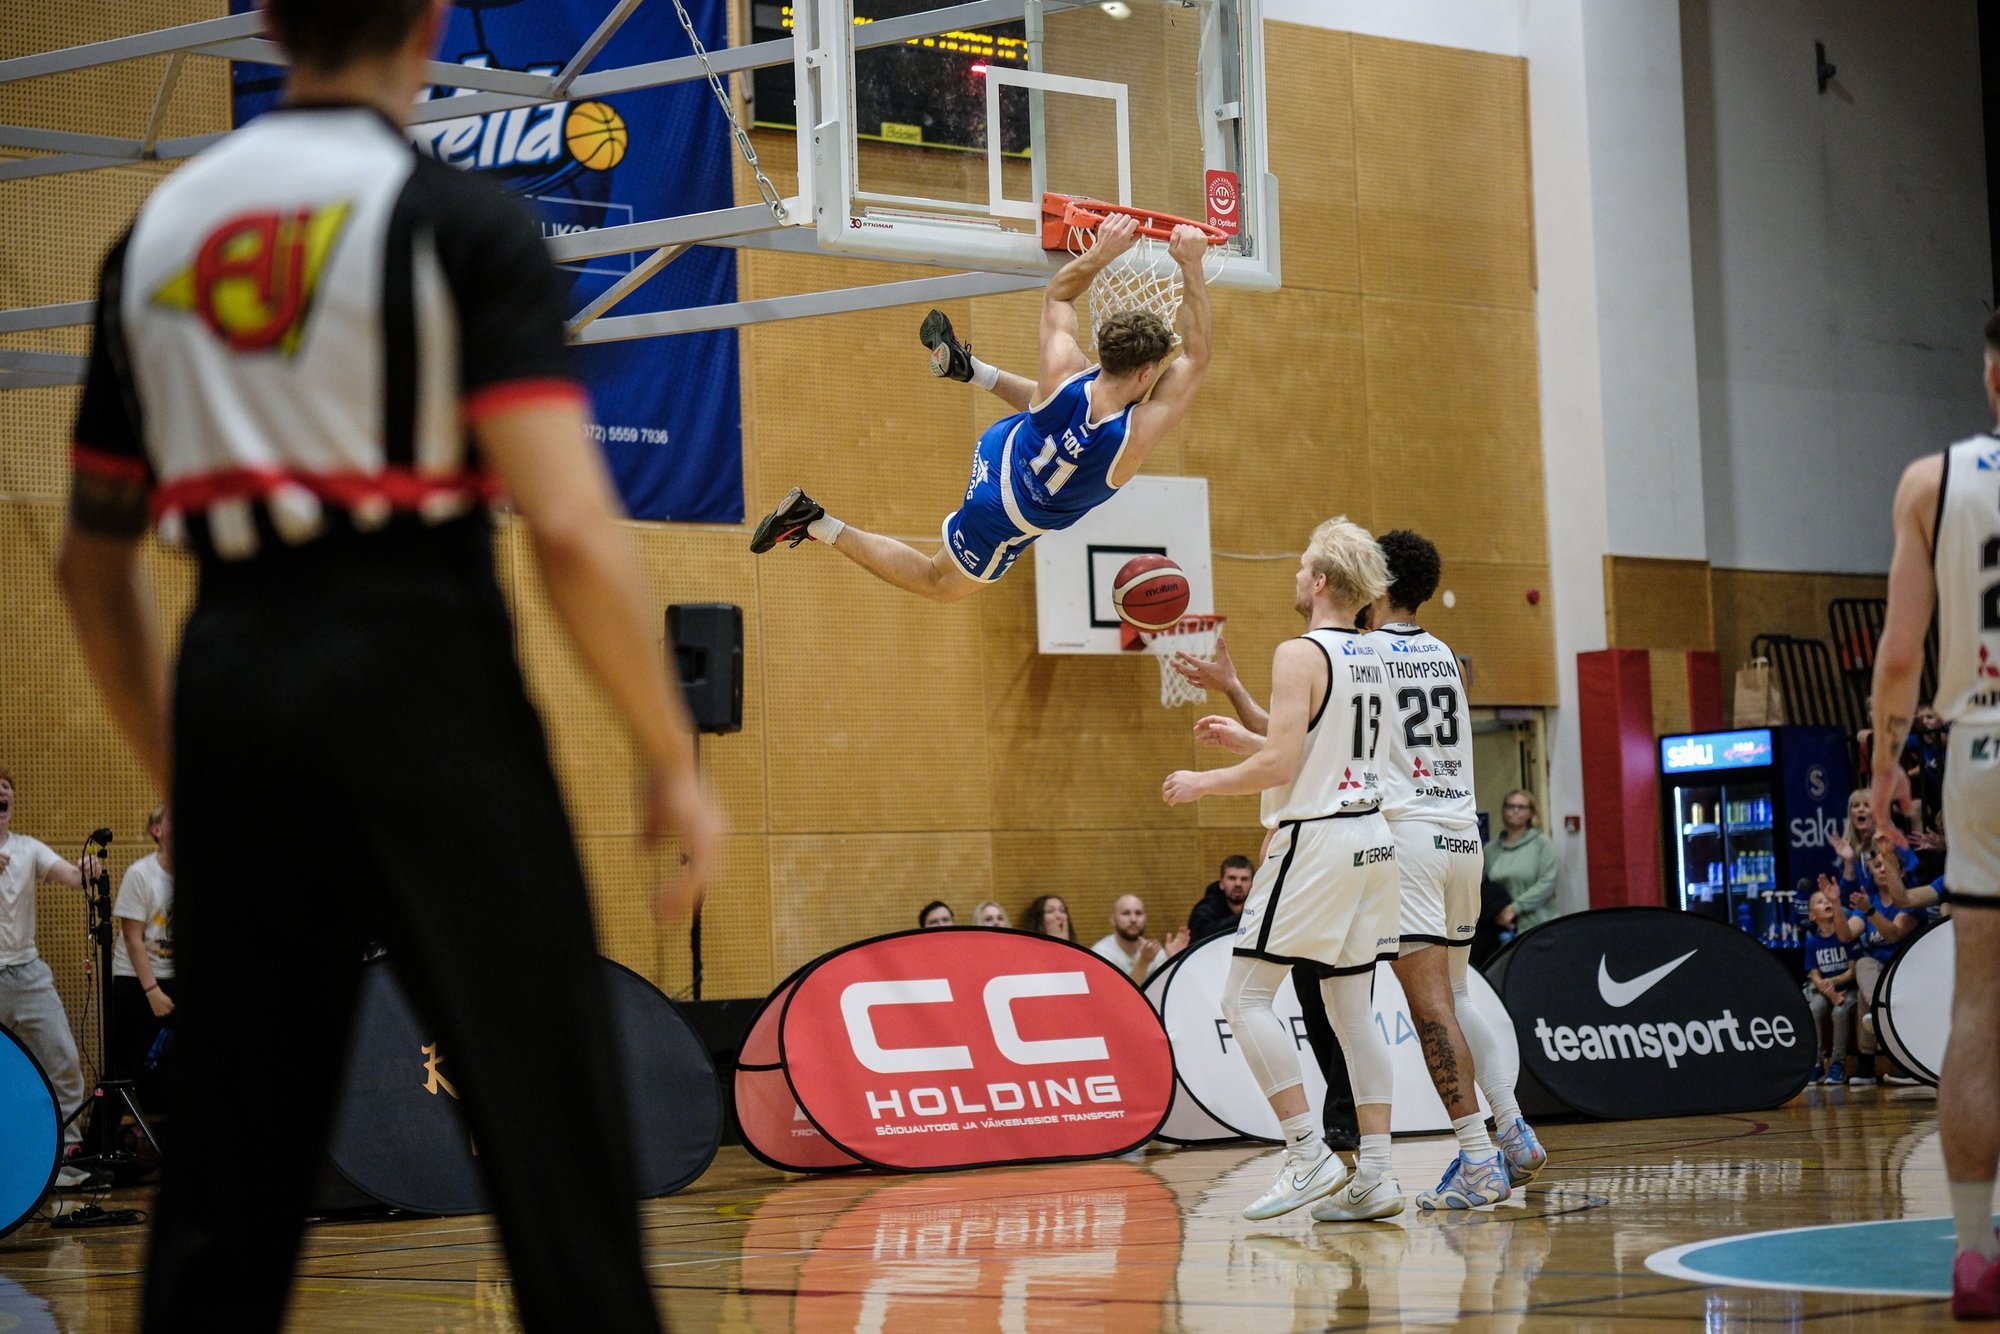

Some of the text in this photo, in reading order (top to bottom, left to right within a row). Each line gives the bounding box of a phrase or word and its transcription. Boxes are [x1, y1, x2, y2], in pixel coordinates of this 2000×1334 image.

[1217, 218, 1237, 228] Optibet
[608, 426, 639, 443] 5559
[641, 428, 669, 445] 7936
[1061, 428, 1085, 459] FOX
[1029, 434, 1078, 496] 11
[1145, 583, 1178, 598] molten
[1409, 645, 1441, 653] VALDEK
[1349, 665, 1382, 683] TAMKIVI
[1386, 662, 1457, 678] THOMPSON
[1396, 685, 1459, 749] 23
[1667, 738, 1713, 768] saku
[1446, 837, 1478, 855] TERRAT
[1816, 946, 1847, 966] KEILA
[840, 972, 1110, 1074] CC
[1534, 1009, 1796, 1069] teamsport.ee
[865, 1076, 1122, 1120] HOLDING
[875, 1110, 1125, 1137] SÕIDUAUTODE JA VÄIKEBUSSIDE TRANSPORT
